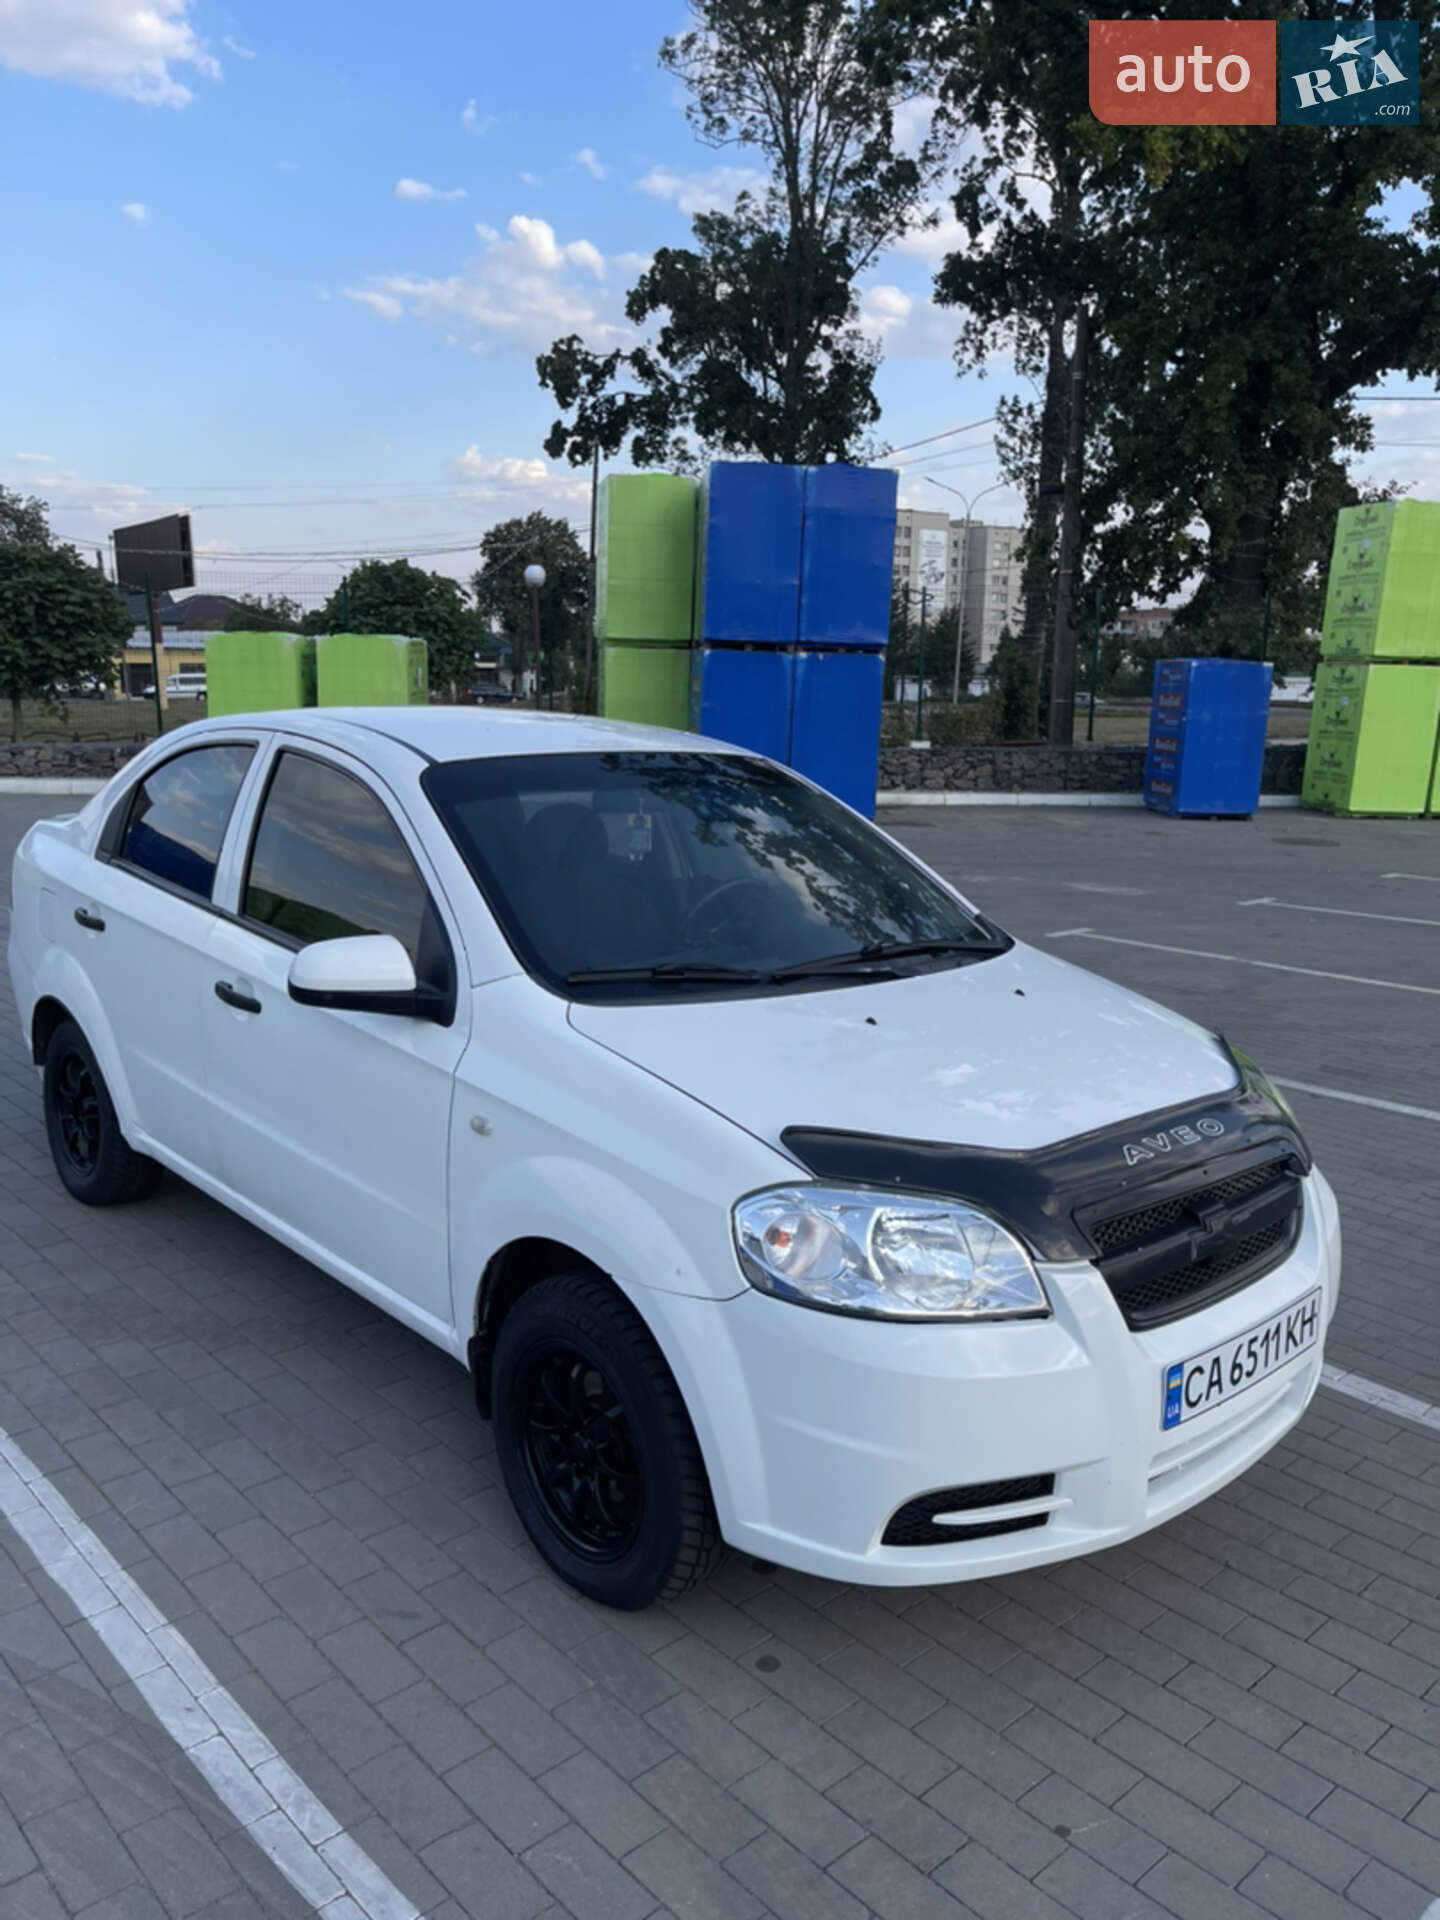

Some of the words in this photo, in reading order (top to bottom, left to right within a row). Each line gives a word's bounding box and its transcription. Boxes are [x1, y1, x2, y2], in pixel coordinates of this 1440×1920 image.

[1123, 1118, 1225, 1166] AVEO
[1184, 1356, 1223, 1409] CA
[1230, 1322, 1282, 1387] 6511
[1285, 1299, 1318, 1355] KH
